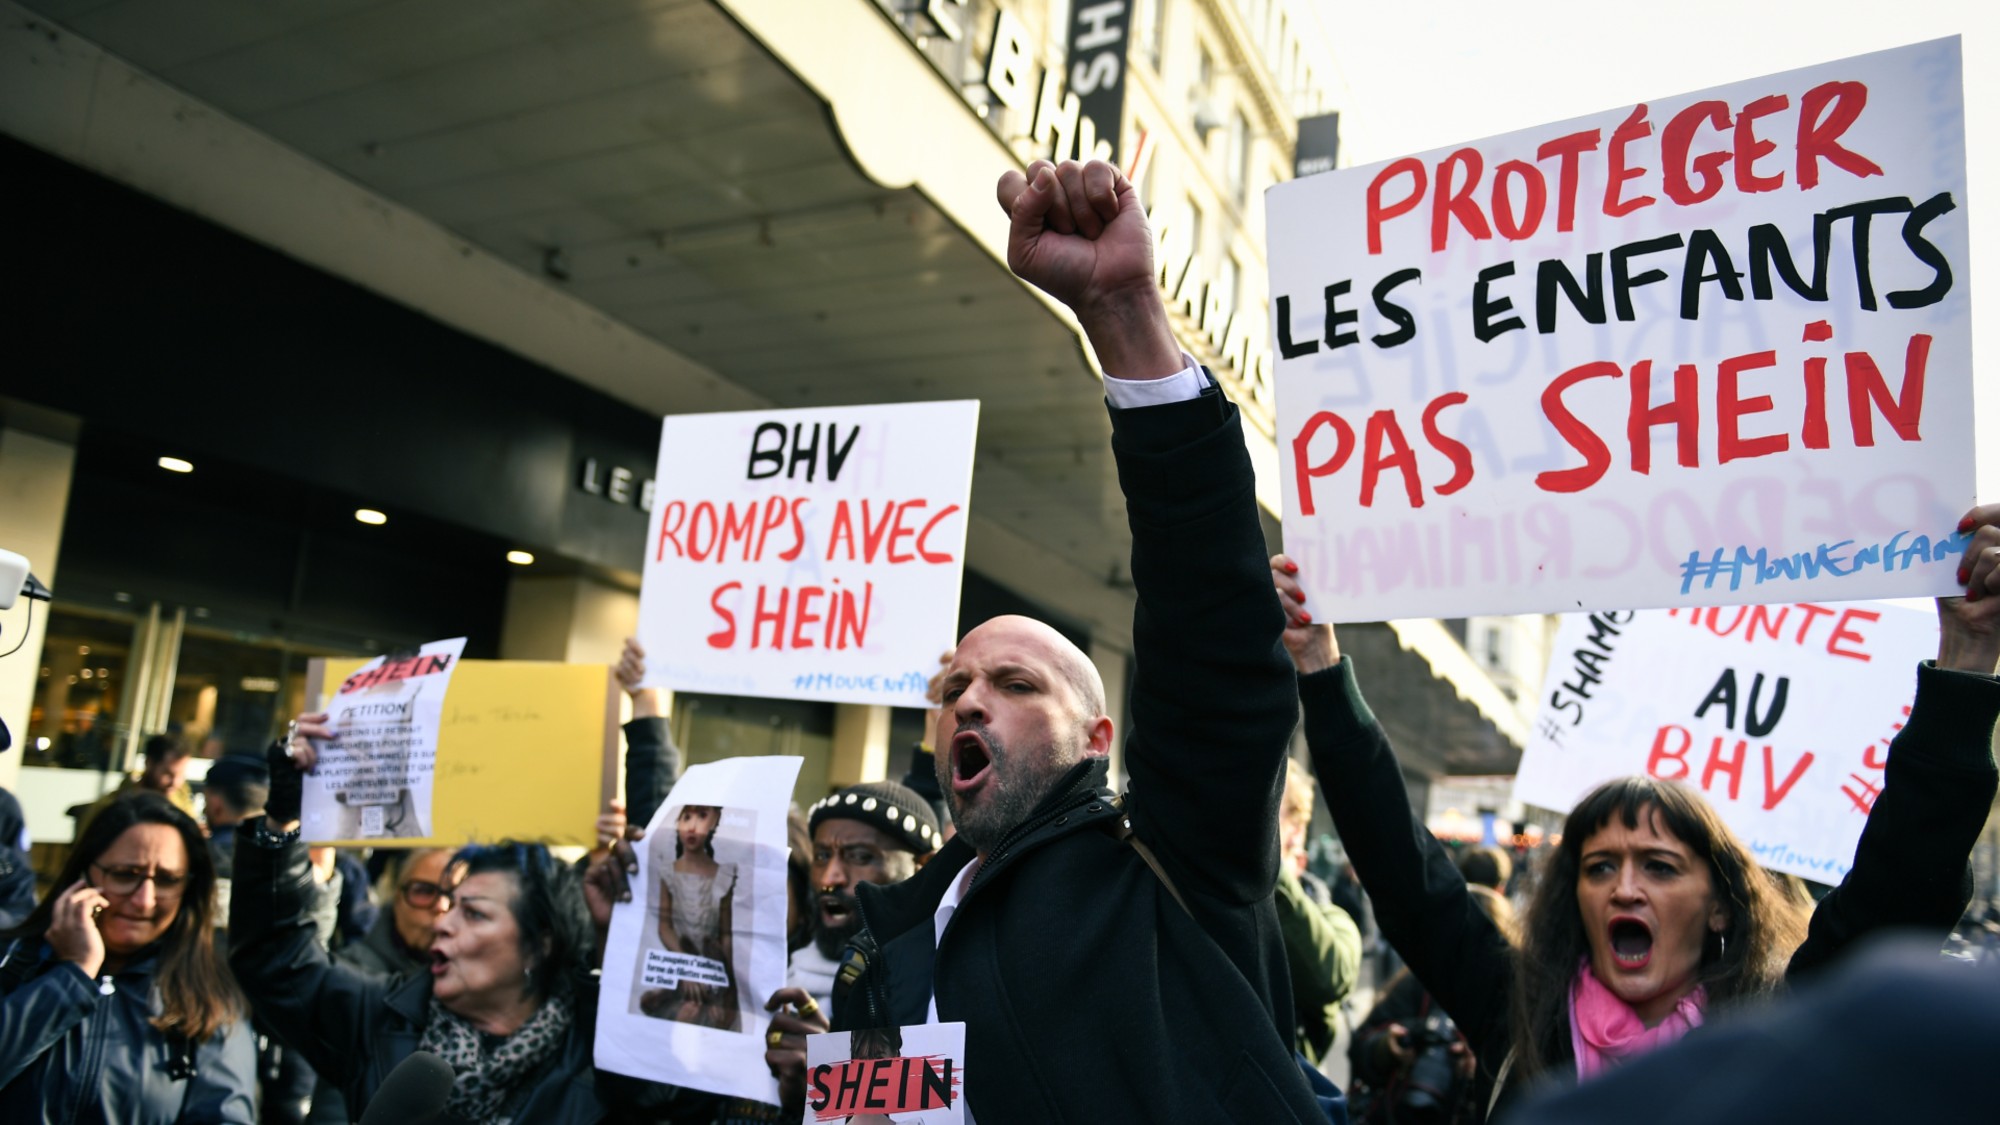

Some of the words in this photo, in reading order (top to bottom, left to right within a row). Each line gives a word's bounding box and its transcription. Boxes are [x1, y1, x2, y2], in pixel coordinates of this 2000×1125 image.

[1366, 80, 1885, 255] PROTÉGER
[1276, 267, 1422, 360] LES
[1473, 191, 1957, 344] ENFANTS
[747, 421, 860, 483] BHV
[1292, 391, 1475, 515] PAS
[656, 496, 811, 563] ROMPS
[826, 498, 960, 564] AVEC
[341, 654, 451, 694] SHEIN
[1694, 668, 1790, 737] AU
[1646, 725, 1814, 811] BHV
[811, 1058, 952, 1111] SHEIN
